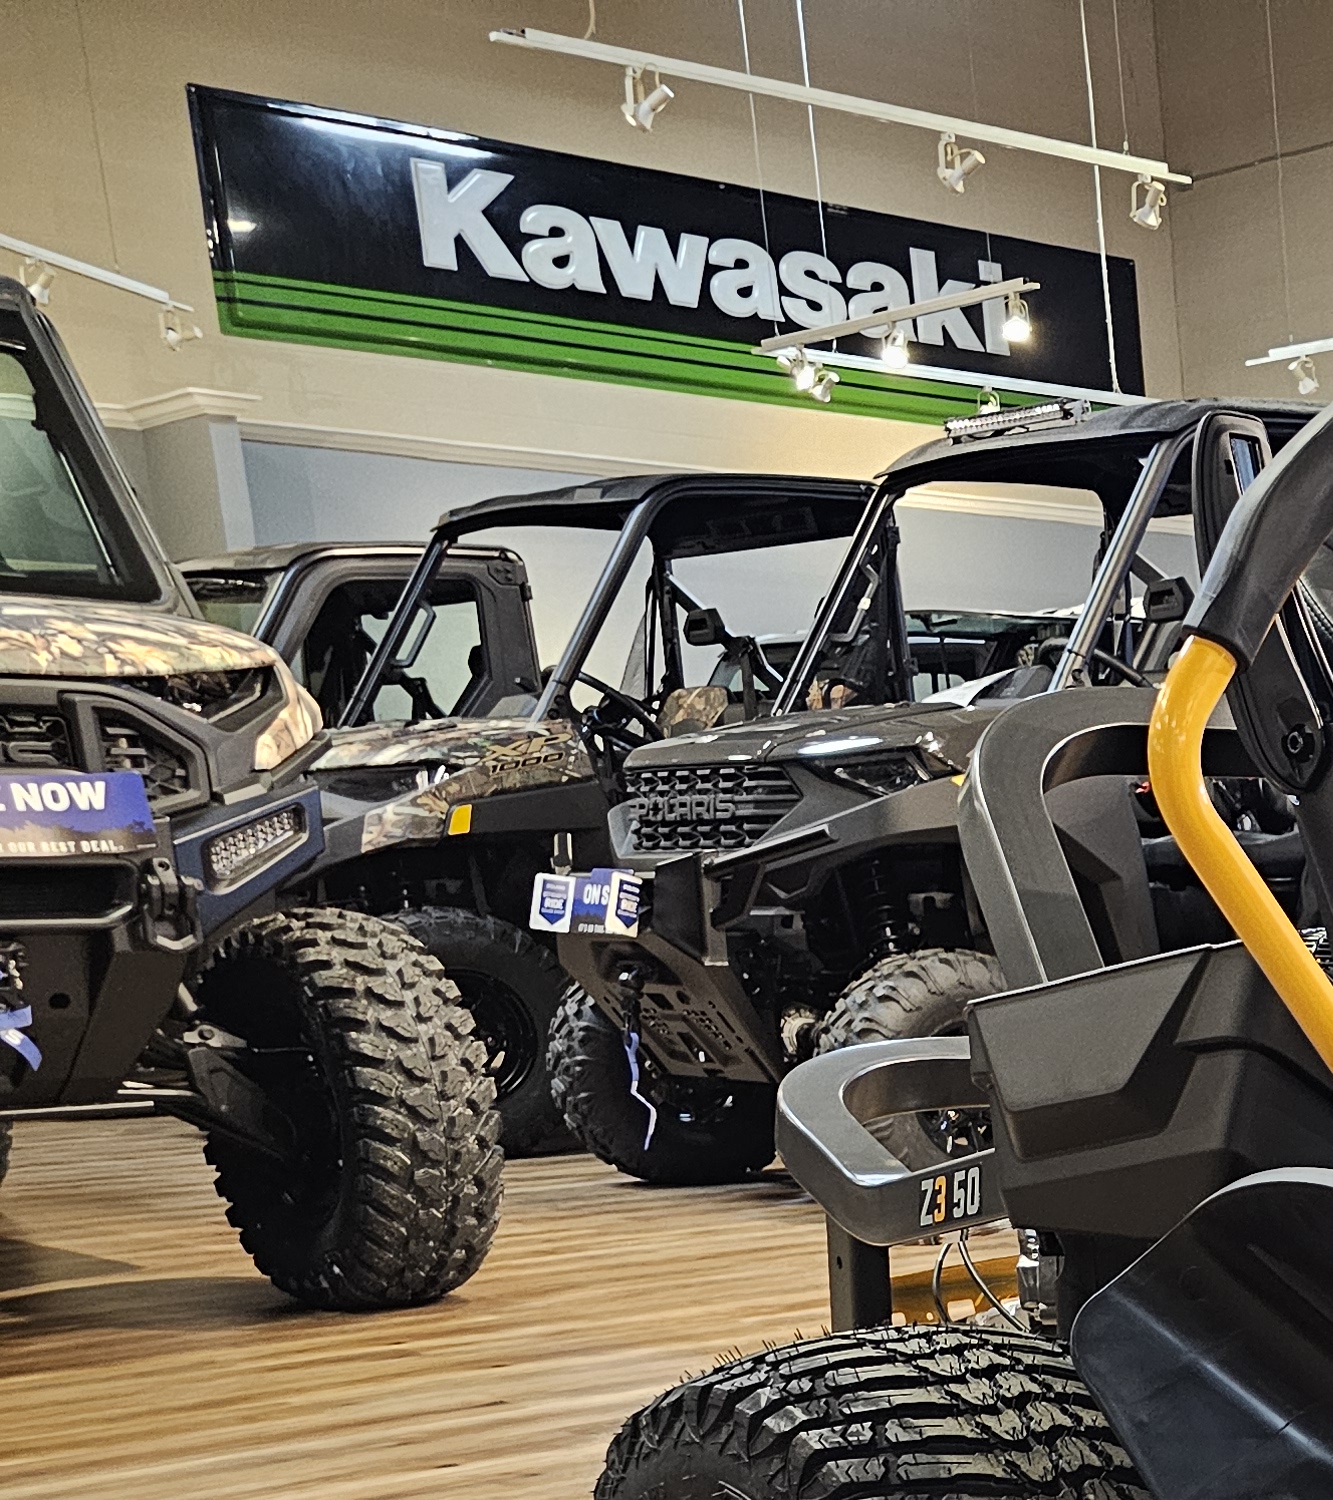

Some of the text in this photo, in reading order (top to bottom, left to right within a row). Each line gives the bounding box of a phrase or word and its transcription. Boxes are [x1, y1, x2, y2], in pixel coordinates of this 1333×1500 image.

[410, 157, 1011, 356] Kawasaki
[480, 732, 573, 763] XP
[490, 752, 564, 775] 1000
[10, 780, 106, 812] NOW
[631, 795, 736, 822] POLARIS
[920, 1166, 981, 1227] Z3 50
